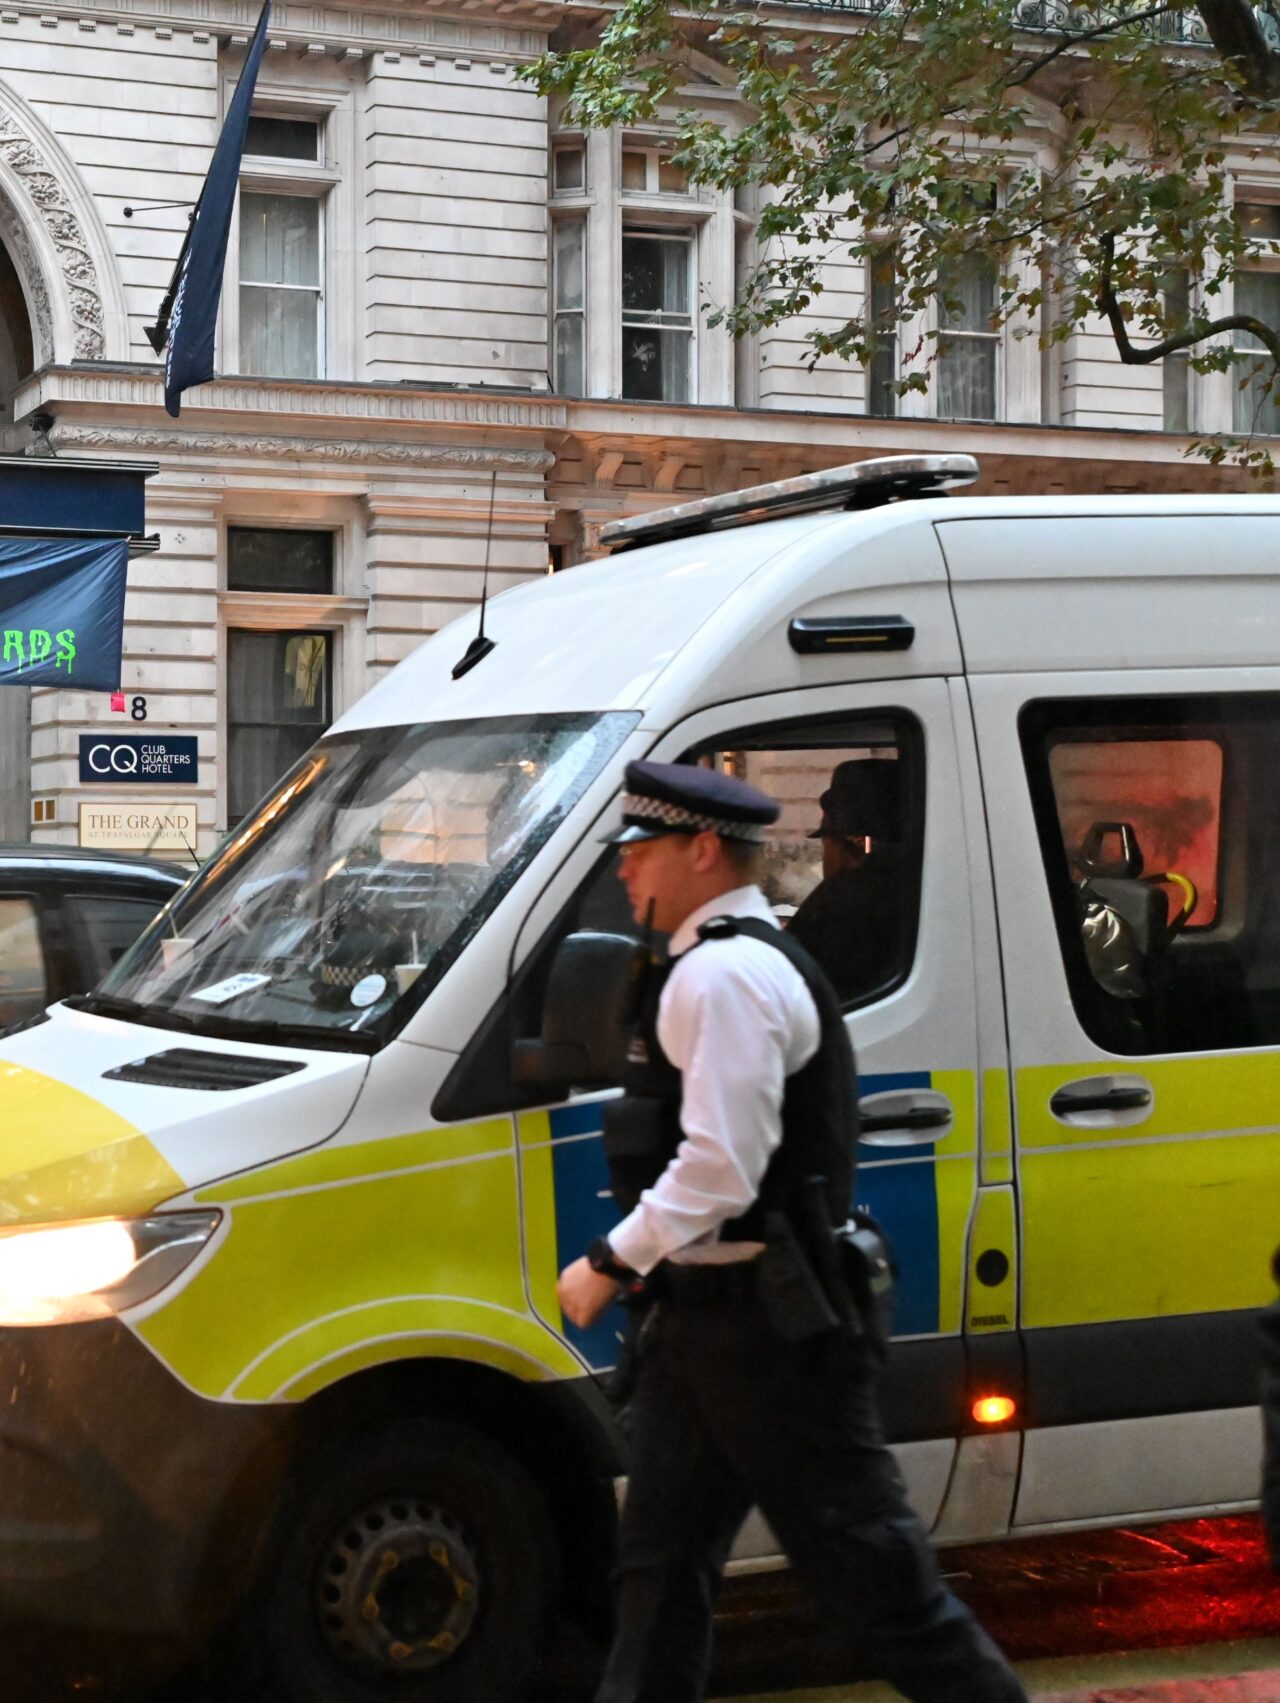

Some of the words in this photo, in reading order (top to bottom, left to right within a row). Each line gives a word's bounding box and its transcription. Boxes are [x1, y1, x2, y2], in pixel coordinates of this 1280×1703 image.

[131, 696, 148, 721] 8
[140, 744, 166, 754] CLUB
[88, 744, 138, 773] CQ
[140, 754, 191, 764] QUARTERS
[141, 764, 173, 773] HOTEL
[88, 814, 122, 829] THE
[127, 815, 189, 829] GRAND
